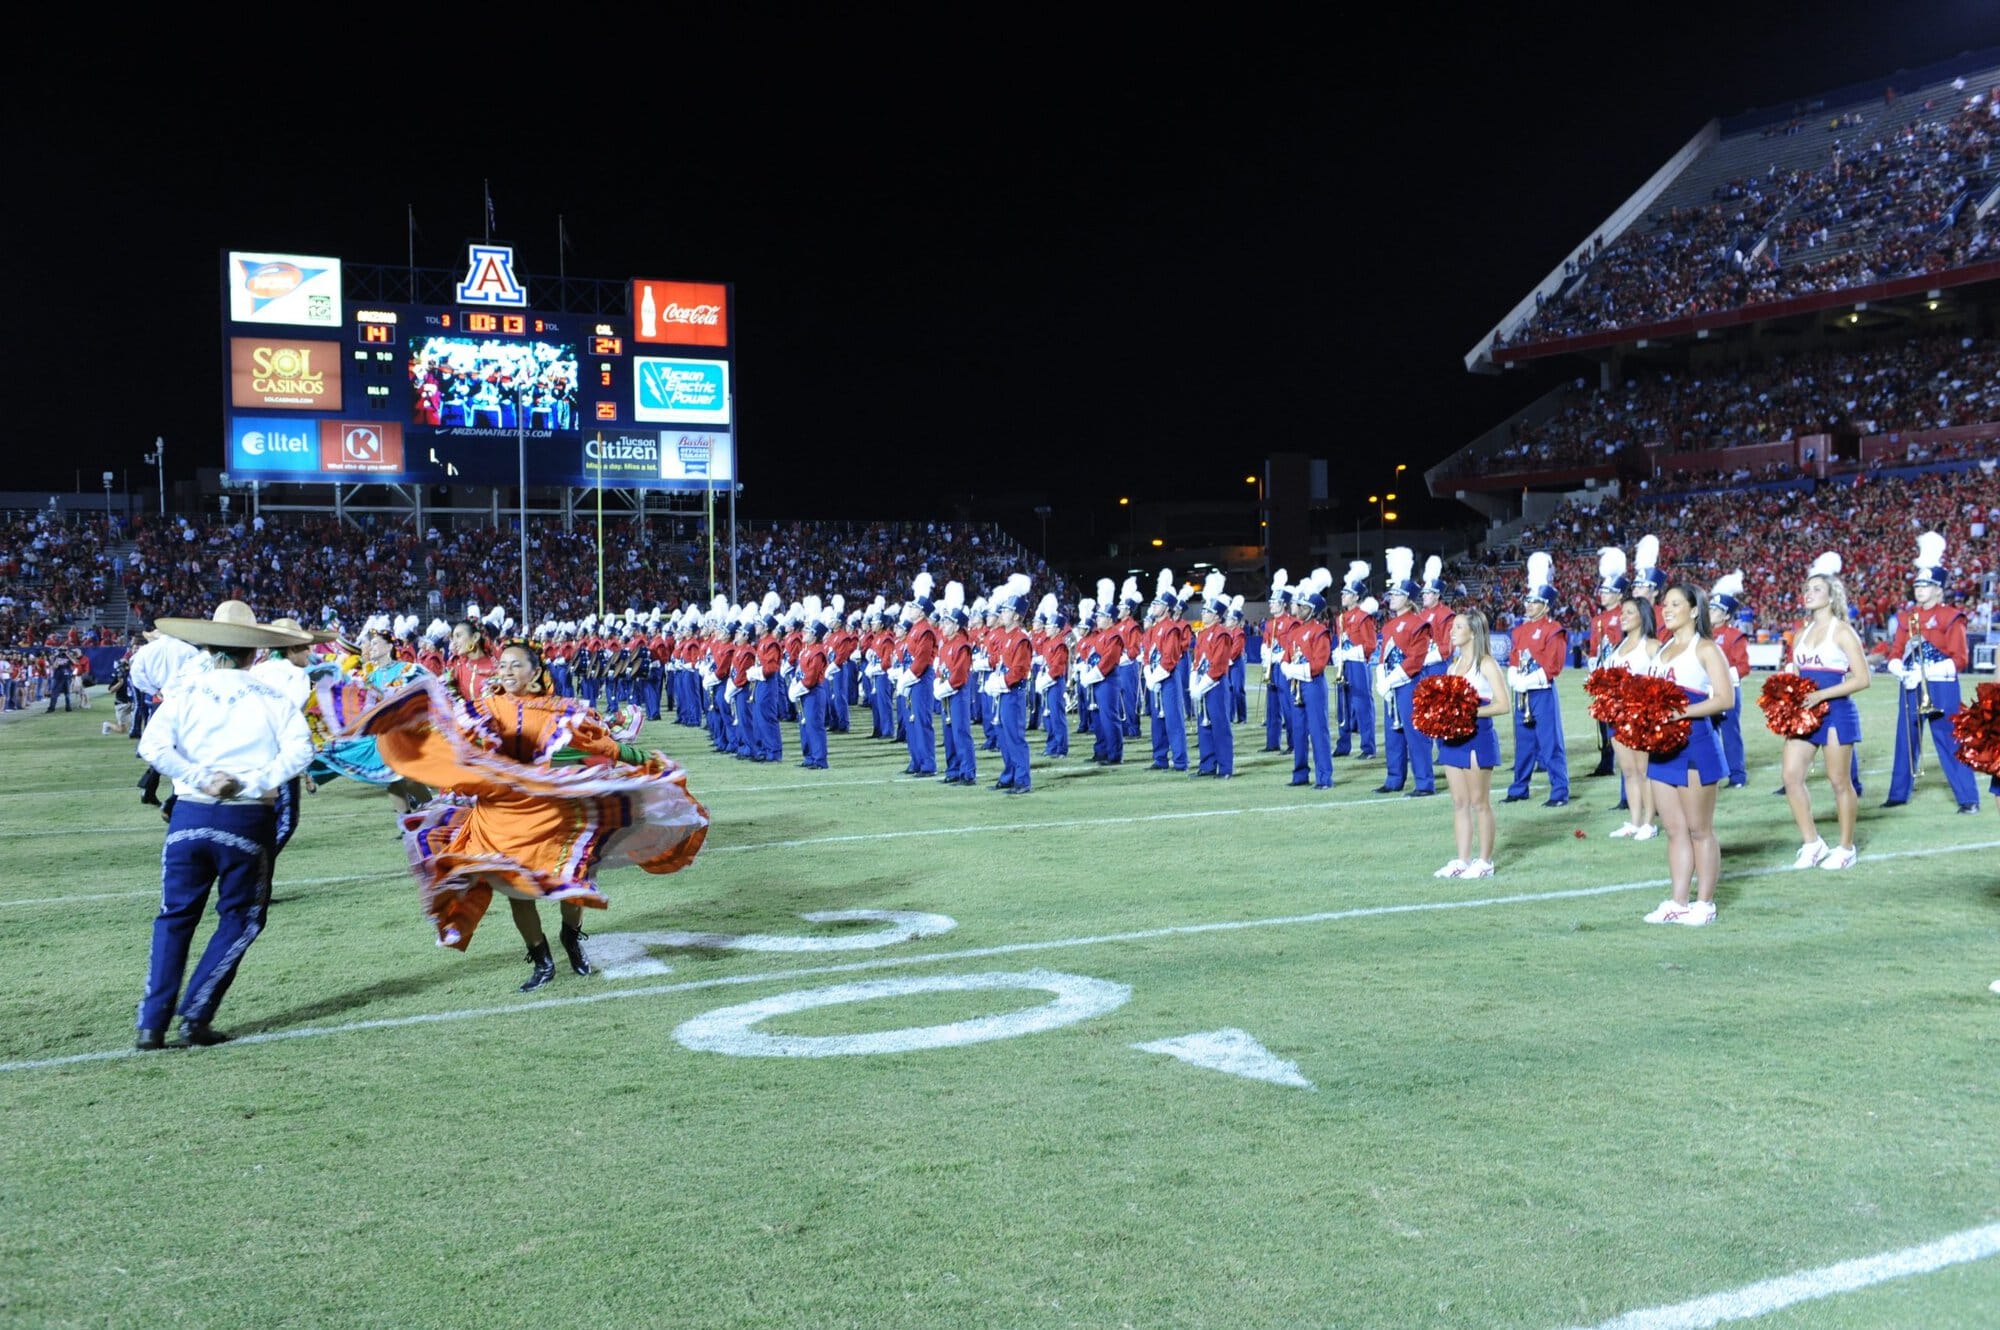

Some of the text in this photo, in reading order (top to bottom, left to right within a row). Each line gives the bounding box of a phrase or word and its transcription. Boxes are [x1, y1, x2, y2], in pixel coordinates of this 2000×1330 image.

[456, 244, 527, 307] A
[425, 316, 440, 324] TOL
[441, 314, 450, 327] 3
[662, 303, 720, 325] Coca-Cola
[366, 325, 387, 341] 14
[535, 320, 543, 332] 3
[544, 323, 559, 331] TOL
[595, 338, 620, 354] 24
[252, 347, 323, 380] SOL
[601, 372, 610, 386] 3
[660, 366, 705, 381] Tucson
[252, 379, 324, 395] CASINOS
[664, 379, 716, 393] Electric
[670, 392, 716, 405] Power
[597, 403, 615, 418] 25
[620, 436, 656, 447] Tucson
[585, 440, 657, 460] Citizen
